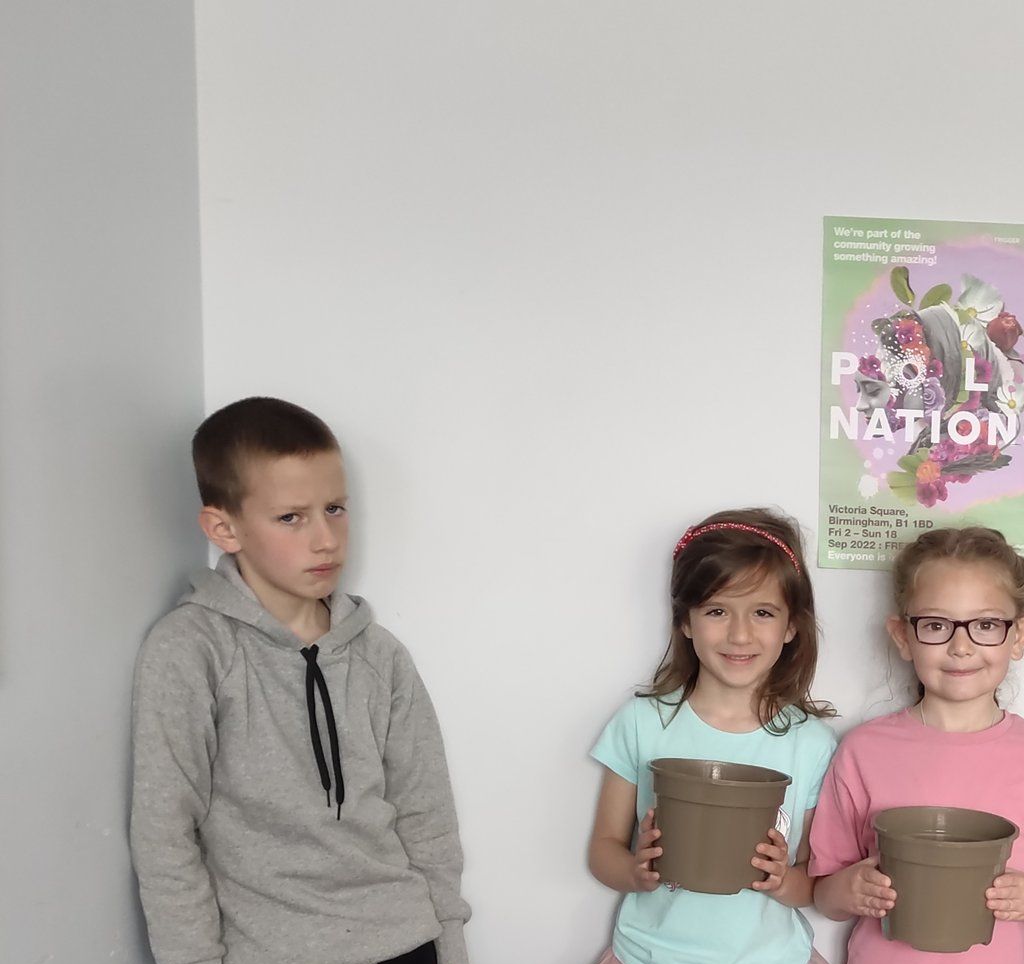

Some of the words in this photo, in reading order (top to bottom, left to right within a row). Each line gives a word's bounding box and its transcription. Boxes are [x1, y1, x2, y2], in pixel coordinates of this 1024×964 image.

[833, 227, 864, 237] We're
[866, 229, 888, 239] part
[890, 229, 902, 239] of
[903, 230, 921, 240] the
[833, 240, 892, 252] community
[893, 242, 936, 254] growing
[833, 252, 888, 264] something
[890, 254, 938, 266] amazing!
[828, 504, 867, 515] Victoria
[869, 506, 909, 517] Square,
[828, 516, 893, 529] Birmingham,
[895, 519, 909, 528] B1
[912, 520, 934, 529] 1BD
[828, 528, 842, 537] Fri
[844, 529, 852, 537] 2
[862, 529, 882, 538] Sun
[884, 530, 898, 539] 18
[828, 539, 848, 550] Sep
[850, 540, 876, 550] 2022
[884, 542, 901, 550] FR
[827, 550, 875, 562] Everyone
[877, 552, 886, 561] is
